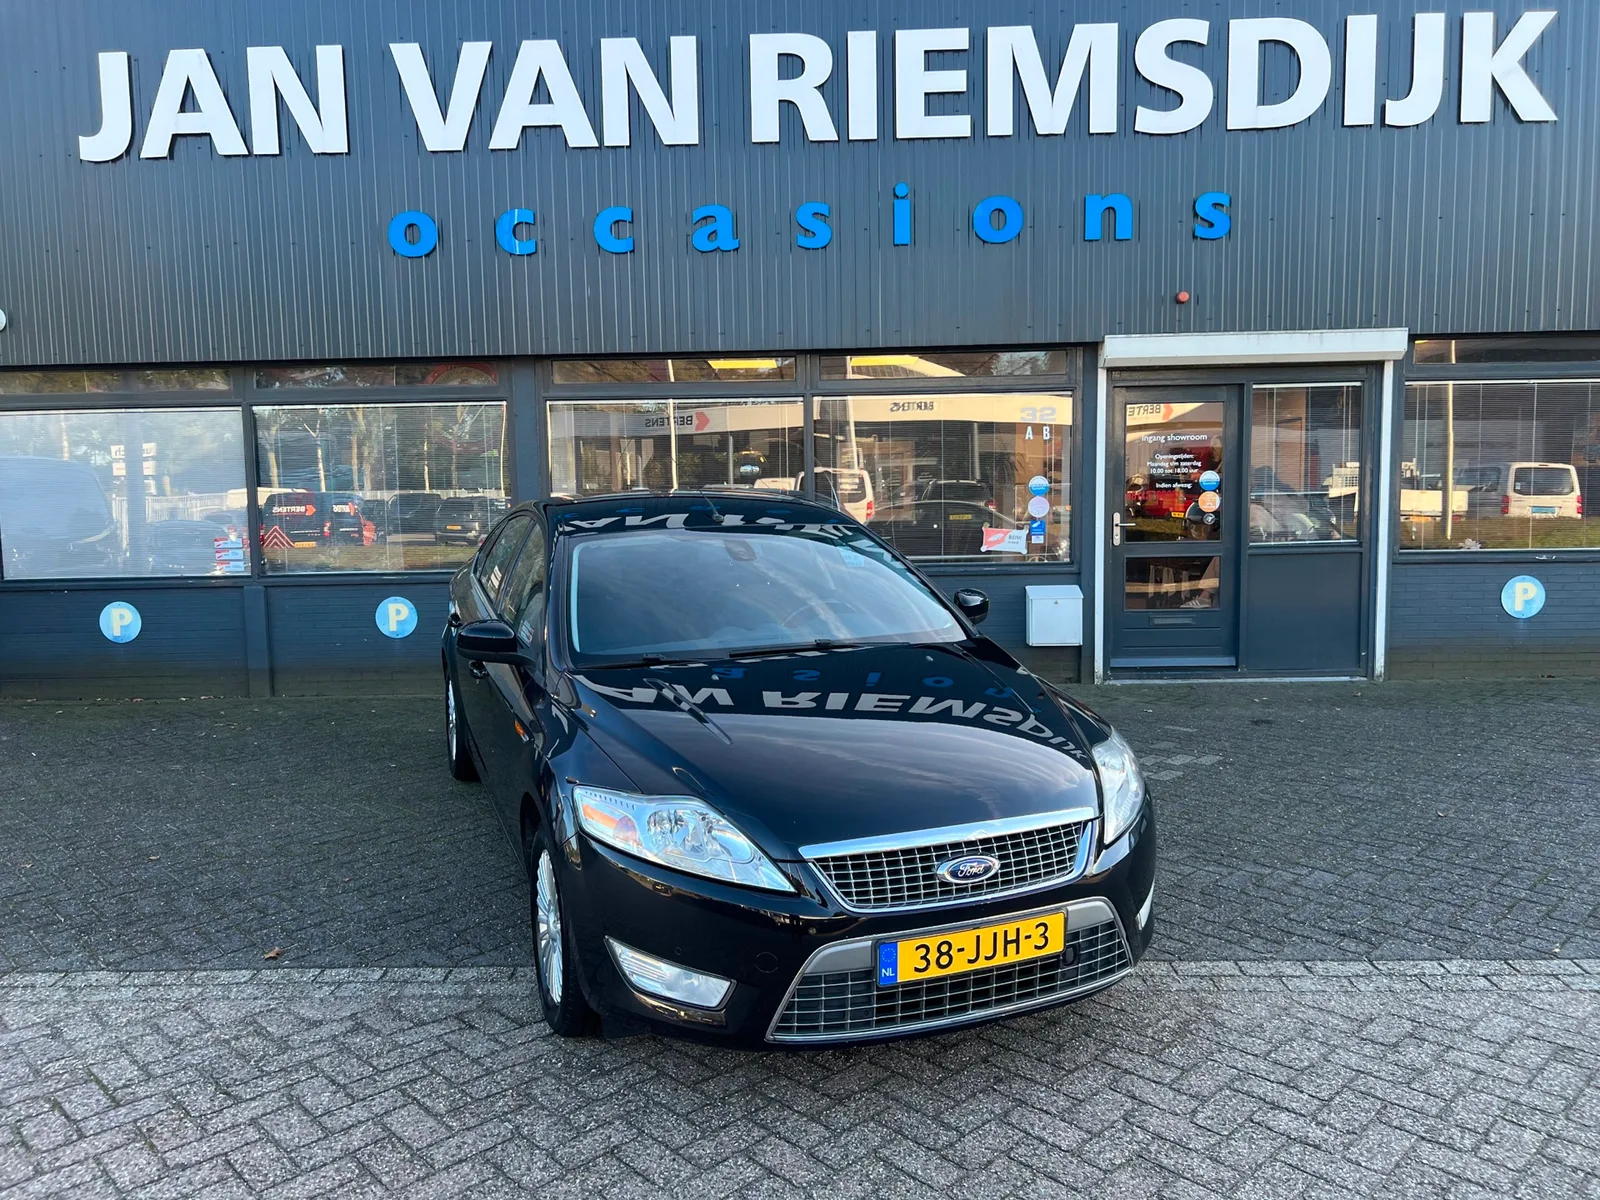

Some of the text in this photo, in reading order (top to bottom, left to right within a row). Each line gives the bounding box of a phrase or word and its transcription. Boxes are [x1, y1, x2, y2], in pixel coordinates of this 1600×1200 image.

[79, 11, 1558, 162] JAN VAN RIEMSDIJK
[387, 182, 1232, 258] occasions
[1020, 407, 1056, 422] 32
[1025, 426, 1051, 440] A B
[1167, 433, 1208, 441] showroom
[1515, 582, 1537, 610] P
[113, 608, 132, 636] P
[389, 603, 409, 632] P
[957, 862, 985, 877] Ford
[913, 921, 1049, 973] 38-JJH-3
[881, 967, 895, 978] NL
